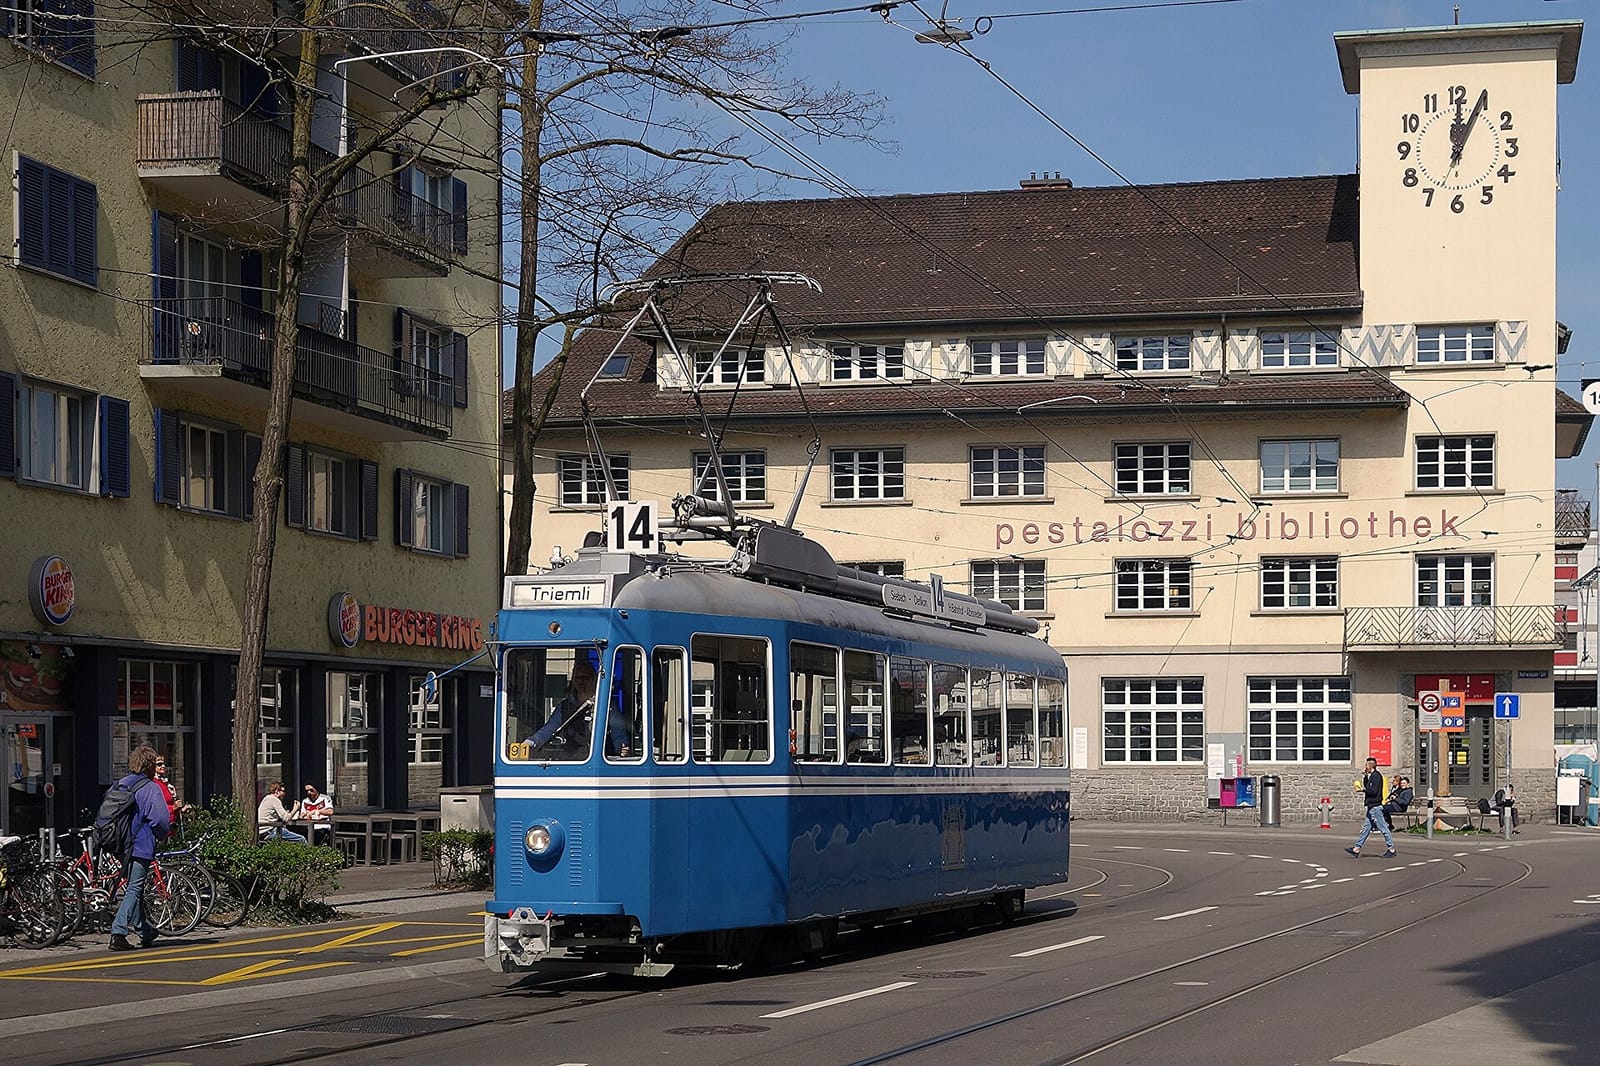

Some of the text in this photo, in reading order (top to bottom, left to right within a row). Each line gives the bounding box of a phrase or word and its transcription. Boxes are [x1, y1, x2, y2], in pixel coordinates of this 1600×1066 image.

[1423, 93, 1438, 113] 11
[1448, 85, 1468, 105] 12
[1401, 113, 1420, 134] 10
[1500, 111, 1513, 131] 2
[1397, 141, 1411, 160] 9
[1504, 137, 1519, 158] 3
[1402, 167, 1419, 187] 8
[1496, 164, 1516, 184] 4
[1422, 187, 1435, 207] 7
[1450, 194, 1465, 214] 6
[1480, 185, 1494, 205] 5
[1589, 391, 1600, 406] 1
[611, 504, 655, 550] 14
[996, 508, 1461, 550] pestalozzi bibliothek
[530, 585, 591, 602] Triemli
[931, 577, 945, 614] 14
[364, 605, 483, 651] BURGER KING
[511, 745, 528, 757] 91
